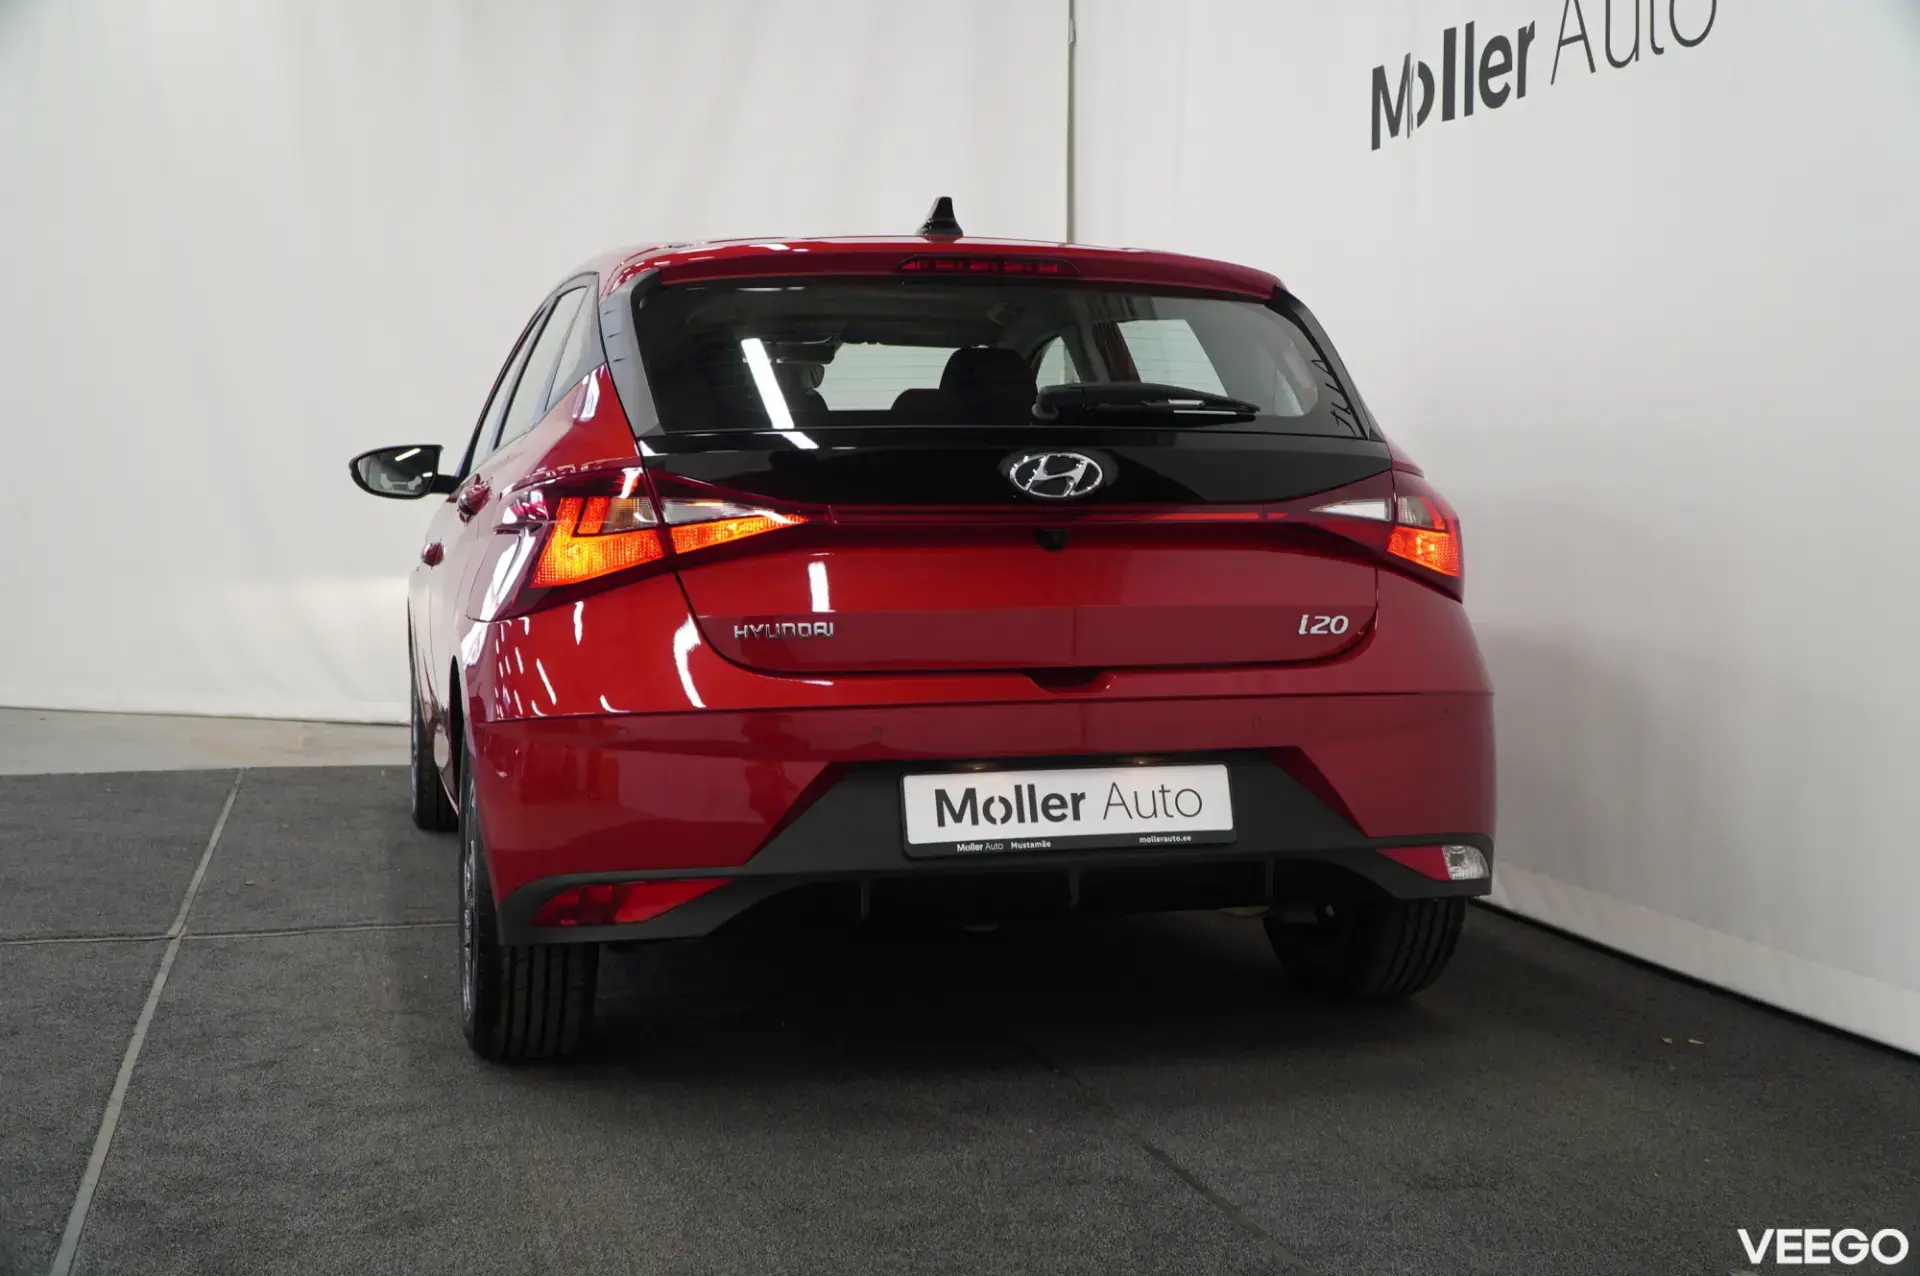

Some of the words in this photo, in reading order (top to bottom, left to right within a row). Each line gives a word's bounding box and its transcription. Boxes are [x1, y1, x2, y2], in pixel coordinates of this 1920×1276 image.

[733, 622, 834, 639] HYUNDAI
[1298, 613, 1349, 635] i20
[1102, 781, 1203, 820] Auto
[984, 842, 1004, 851] Auto
[1010, 840, 1052, 850] Mustamäe
[1139, 835, 1192, 844] mollerauto.ee
